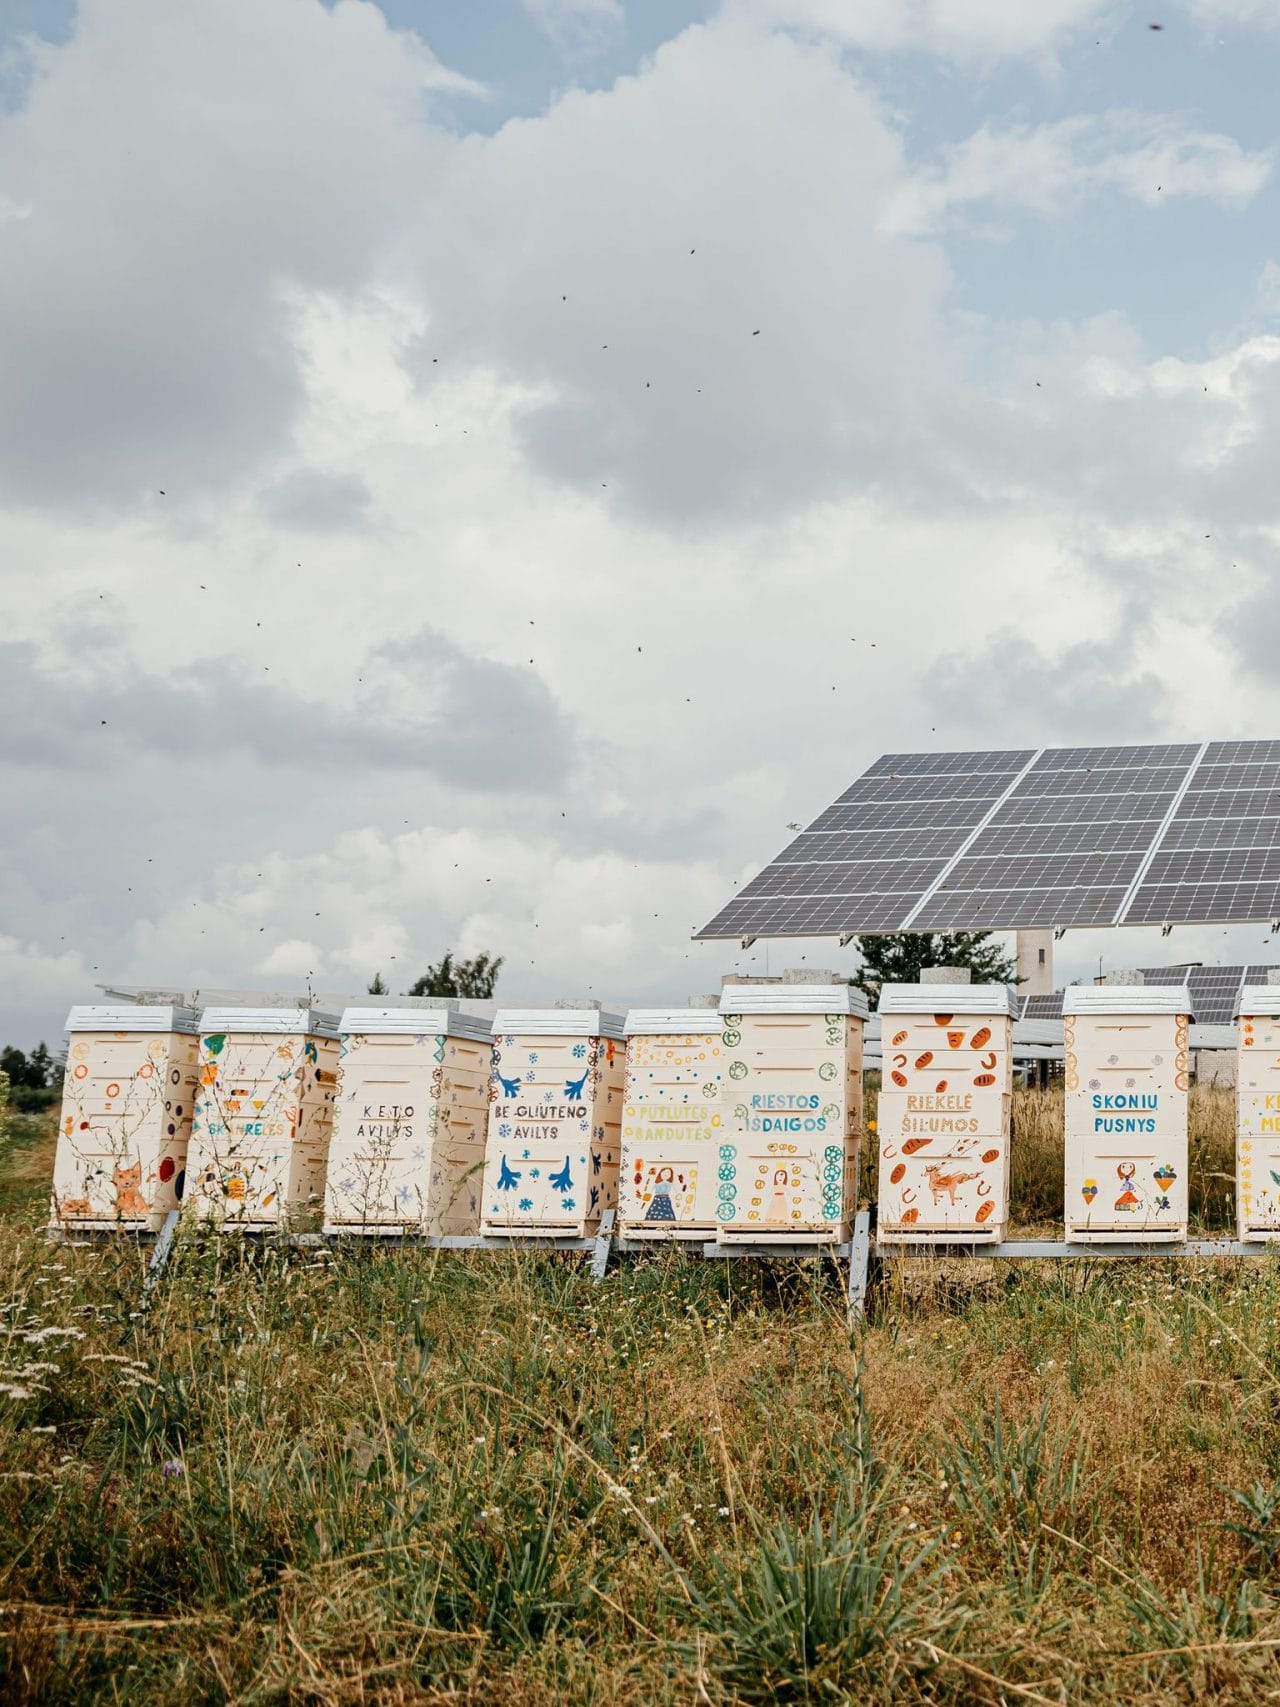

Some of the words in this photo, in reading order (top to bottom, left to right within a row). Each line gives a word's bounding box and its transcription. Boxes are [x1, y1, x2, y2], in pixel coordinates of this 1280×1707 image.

[752, 1094, 820, 1109] RIESTOS
[363, 1105, 415, 1118] KETO
[494, 1105, 510, 1119] BE
[516, 1105, 588, 1119] GLIUTENO
[357, 1124, 413, 1138] AVILYS
[513, 1125, 559, 1139] AVILYS
[1094, 1118, 1156, 1133] PUSNYS
